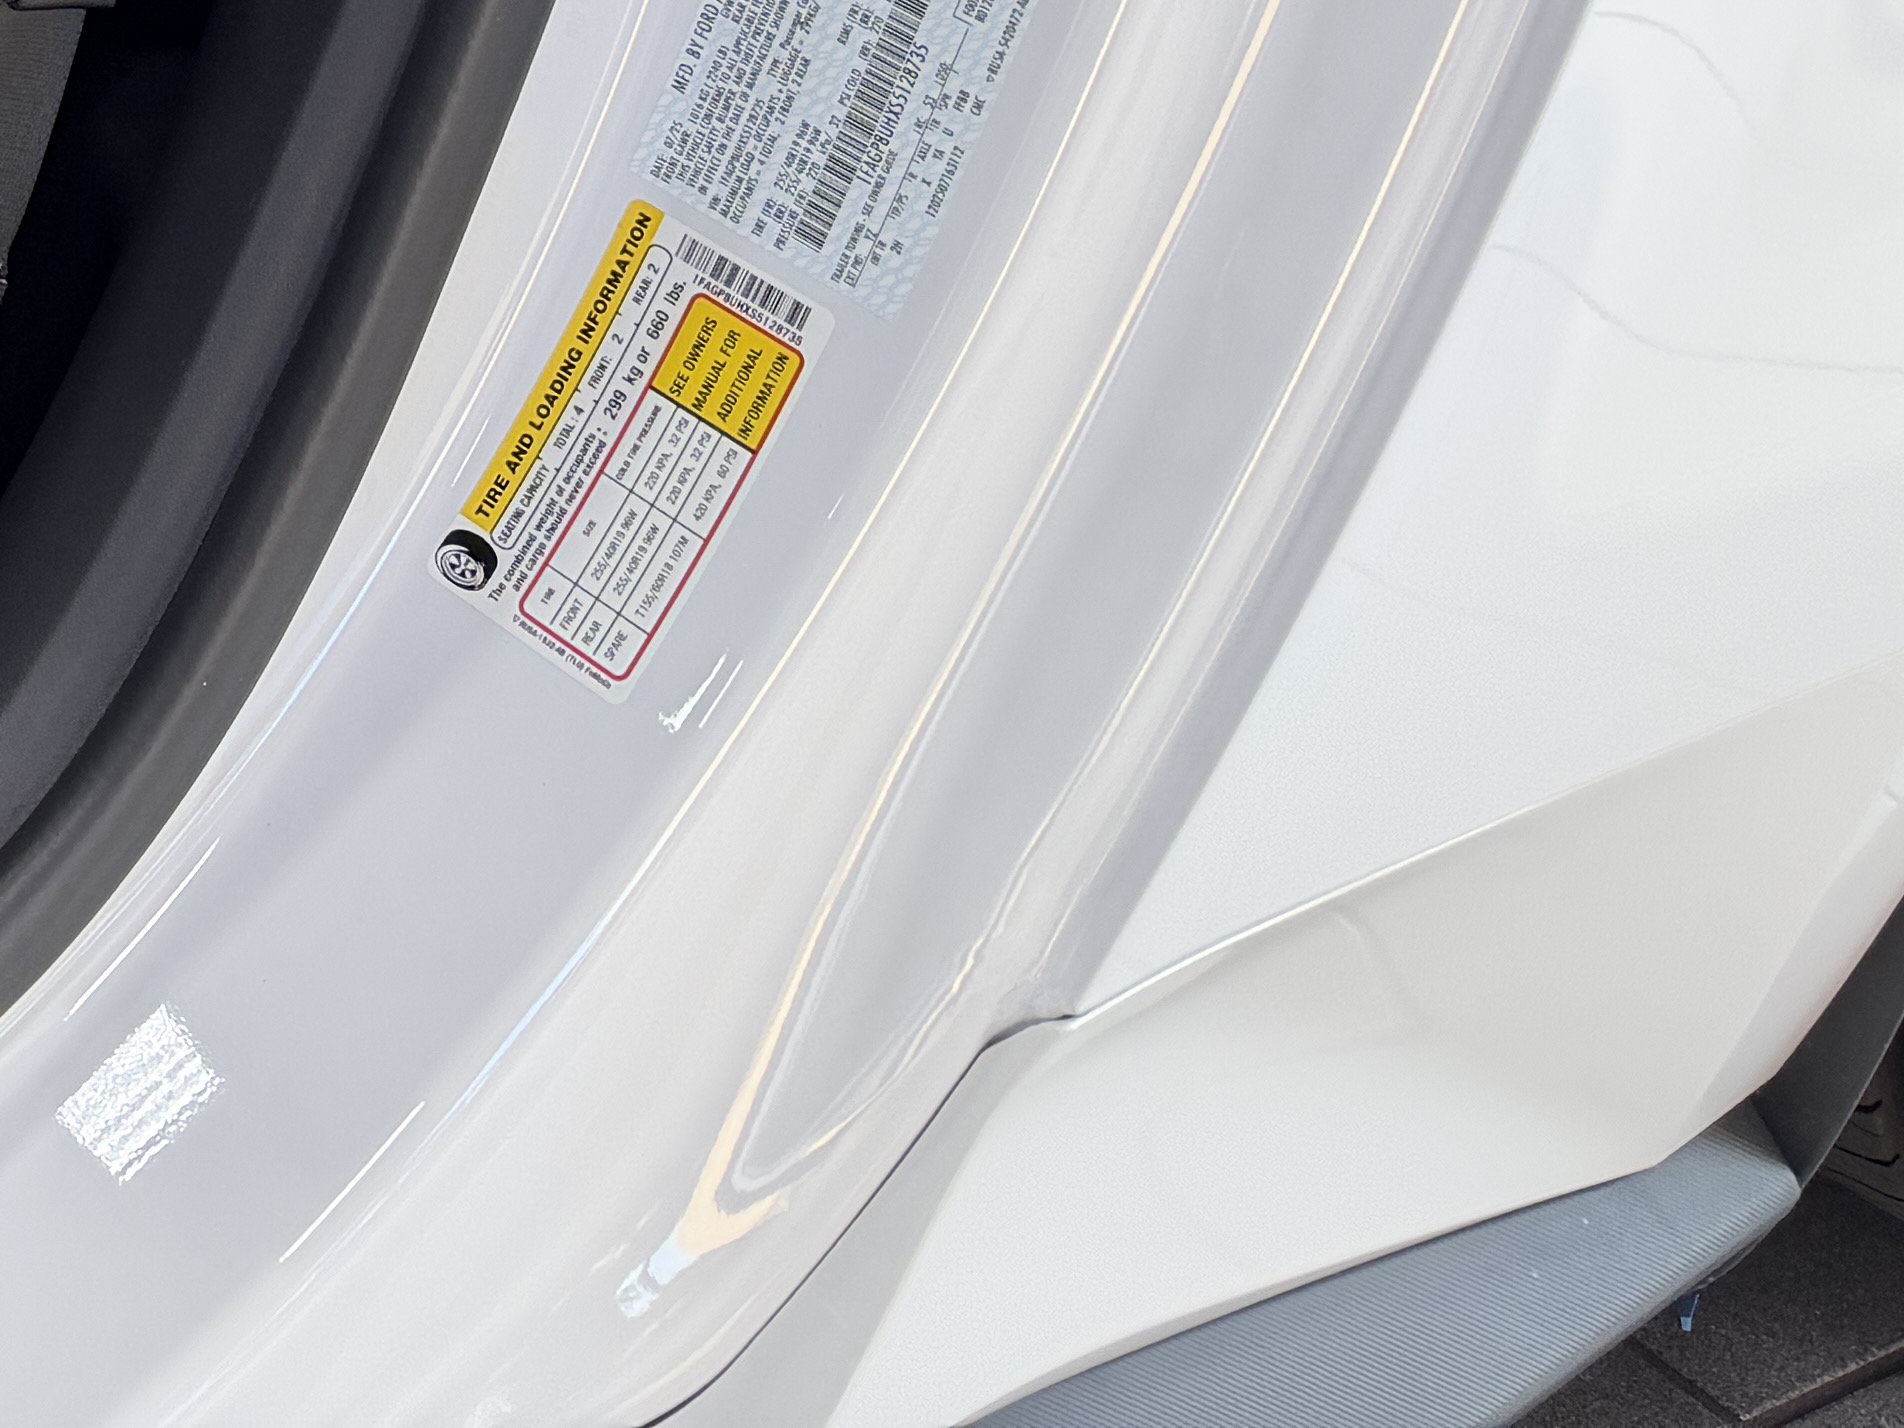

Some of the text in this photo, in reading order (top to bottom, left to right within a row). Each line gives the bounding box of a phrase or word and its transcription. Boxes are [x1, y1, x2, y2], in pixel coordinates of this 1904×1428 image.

[685, 38, 705, 60] BY
[693, 1, 719, 40] FORD
[731, 1, 747, 25] REAR
[670, 57, 696, 95] MFD.
[856, 39, 930, 186] 1FAGP8UHXS5128735
[660, 155, 679, 184] FRONT
[687, 100, 704, 125] 1016
[697, 87, 710, 103] KG
[662, 118, 683, 150] 07/25
[718, 44, 802, 219] MAXIMUM LOAD OCCUPANTS LUGGAGE
[729, 173, 759, 226] OCCUPANTS
[755, 157, 766, 167] 4
[774, 116, 785, 125] 2
[791, 78, 801, 87] 2
[860, 201, 874, 218] SEE
[920, 177, 932, 187] X
[773, 207, 799, 251] PRESSURE
[631, 262, 660, 305] REAR: 2
[692, 273, 804, 347] 1FAGP8UHXS5128735
[474, 211, 657, 522] TIRE AND LOADING INFORMATION
[586, 332, 624, 390] FRONT: 2
[601, 276, 687, 420] 299 kg or 660 lbs.
[667, 315, 719, 398] SEE OWNERS
[689, 328, 742, 412] MANUAL FOR
[714, 345, 764, 423] ADDITIONAL
[571, 403, 584, 417] 4
[636, 403, 662, 443] PRESSURE
[734, 351, 791, 440] INFORMATION
[643, 416, 690, 491] 220 KPA, 32 PSI
[665, 430, 712, 505] 220 KPA, 32 PSI
[692, 446, 738, 522] 420 KPA, 60 PSI
[487, 430, 597, 604] The combined weight of occupants
[497, 462, 550, 546] SEATING CAPACITY
[511, 438, 606, 593] and cargo should never exceed
[590, 528, 626, 583] 255/40R19
[612, 522, 660, 597] 255/40R19 96W
[634, 533, 689, 621] T155/60R18 107M
[558, 596, 584, 632] FRONT
[580, 618, 601, 647] REAR
[603, 628, 628, 663] SPARE
